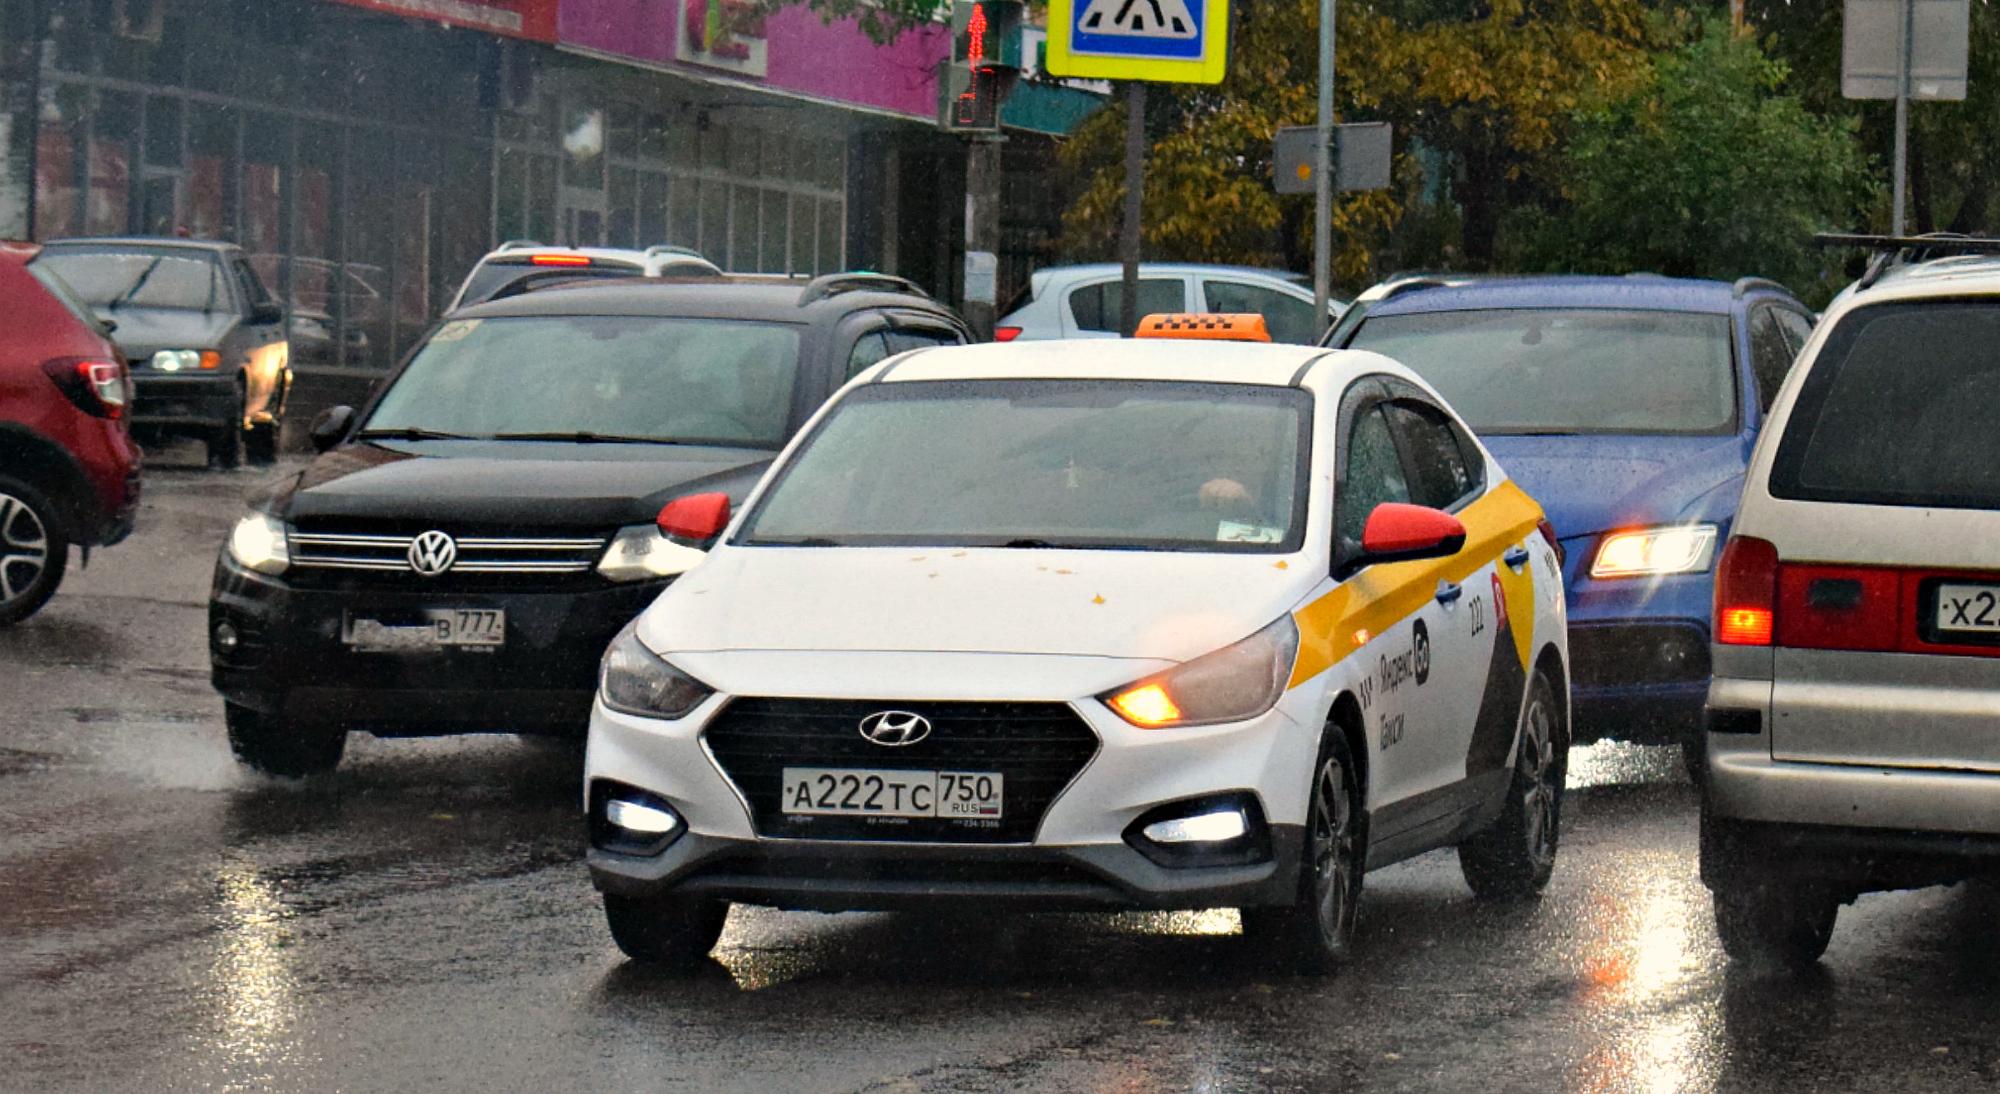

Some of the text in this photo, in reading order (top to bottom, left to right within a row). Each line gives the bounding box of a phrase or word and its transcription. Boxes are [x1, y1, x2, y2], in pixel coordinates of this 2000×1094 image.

[457, 611, 497, 632] 777
[793, 773, 993, 811] А222ТС 750
[952, 803, 978, 814] RUS
